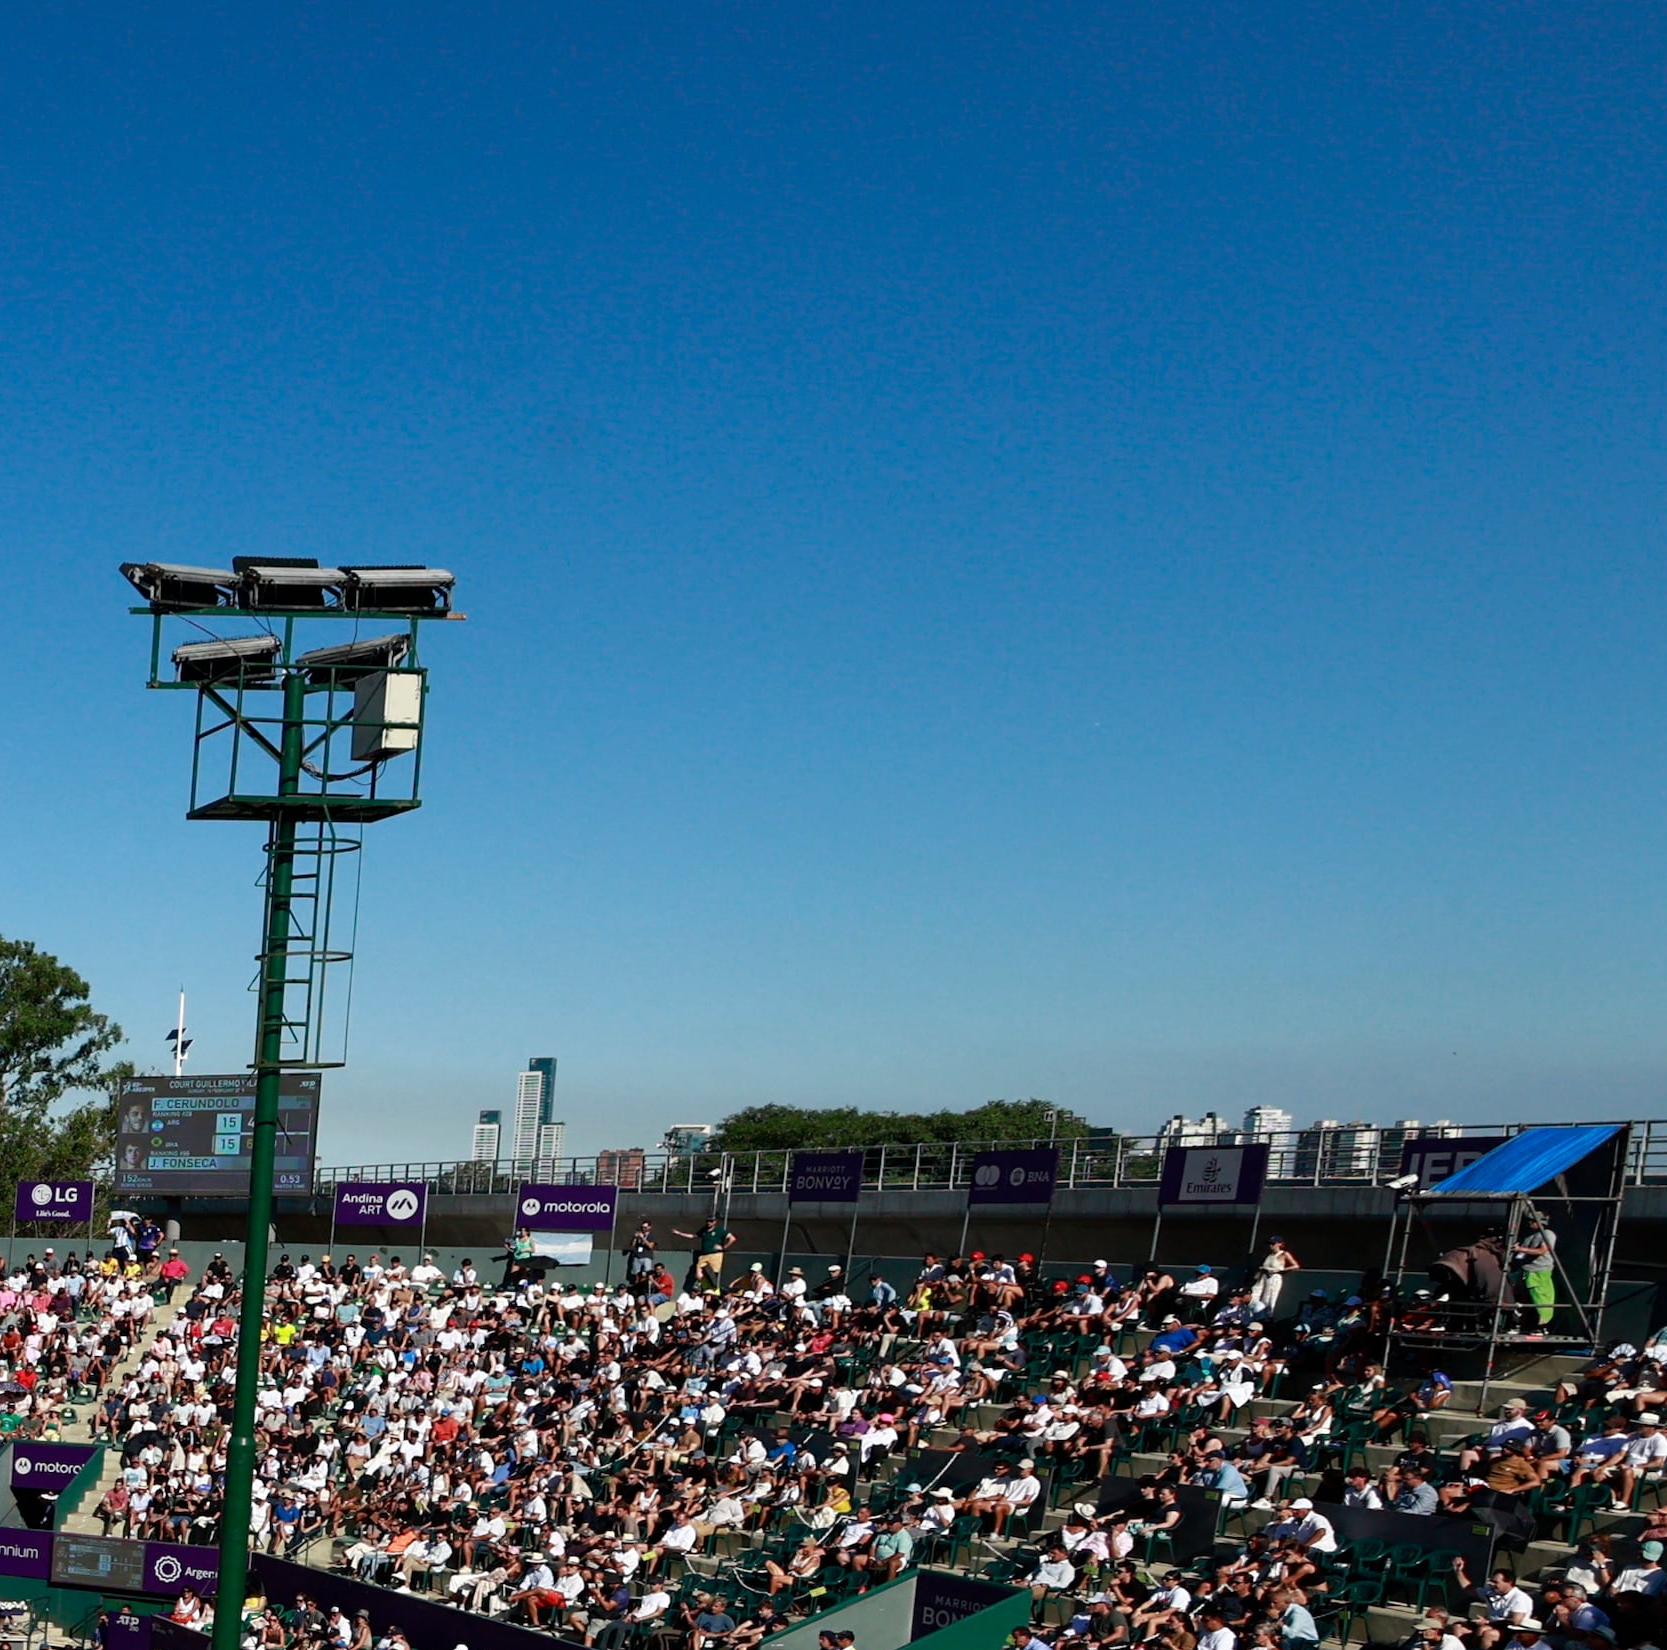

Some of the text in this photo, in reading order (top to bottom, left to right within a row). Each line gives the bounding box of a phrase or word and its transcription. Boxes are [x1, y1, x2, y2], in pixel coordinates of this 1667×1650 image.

[167, 1098, 240, 1109] CERUNDOLO
[222, 1117, 236, 1128] 15
[220, 1138, 235, 1149] 15
[150, 1158, 217, 1168] J. FONSECA
[1026, 1171, 1050, 1182] BNA
[795, 1175, 851, 1190] BONVOY
[1186, 1181, 1232, 1194] Emirates
[54, 1187, 78, 1203] LG
[342, 1193, 383, 1204] Andina
[358, 1205, 383, 1215] ART
[544, 1201, 611, 1213] motorola
[34, 1462, 85, 1474] motoro
[934, 1594, 988, 1611] MARRIO
